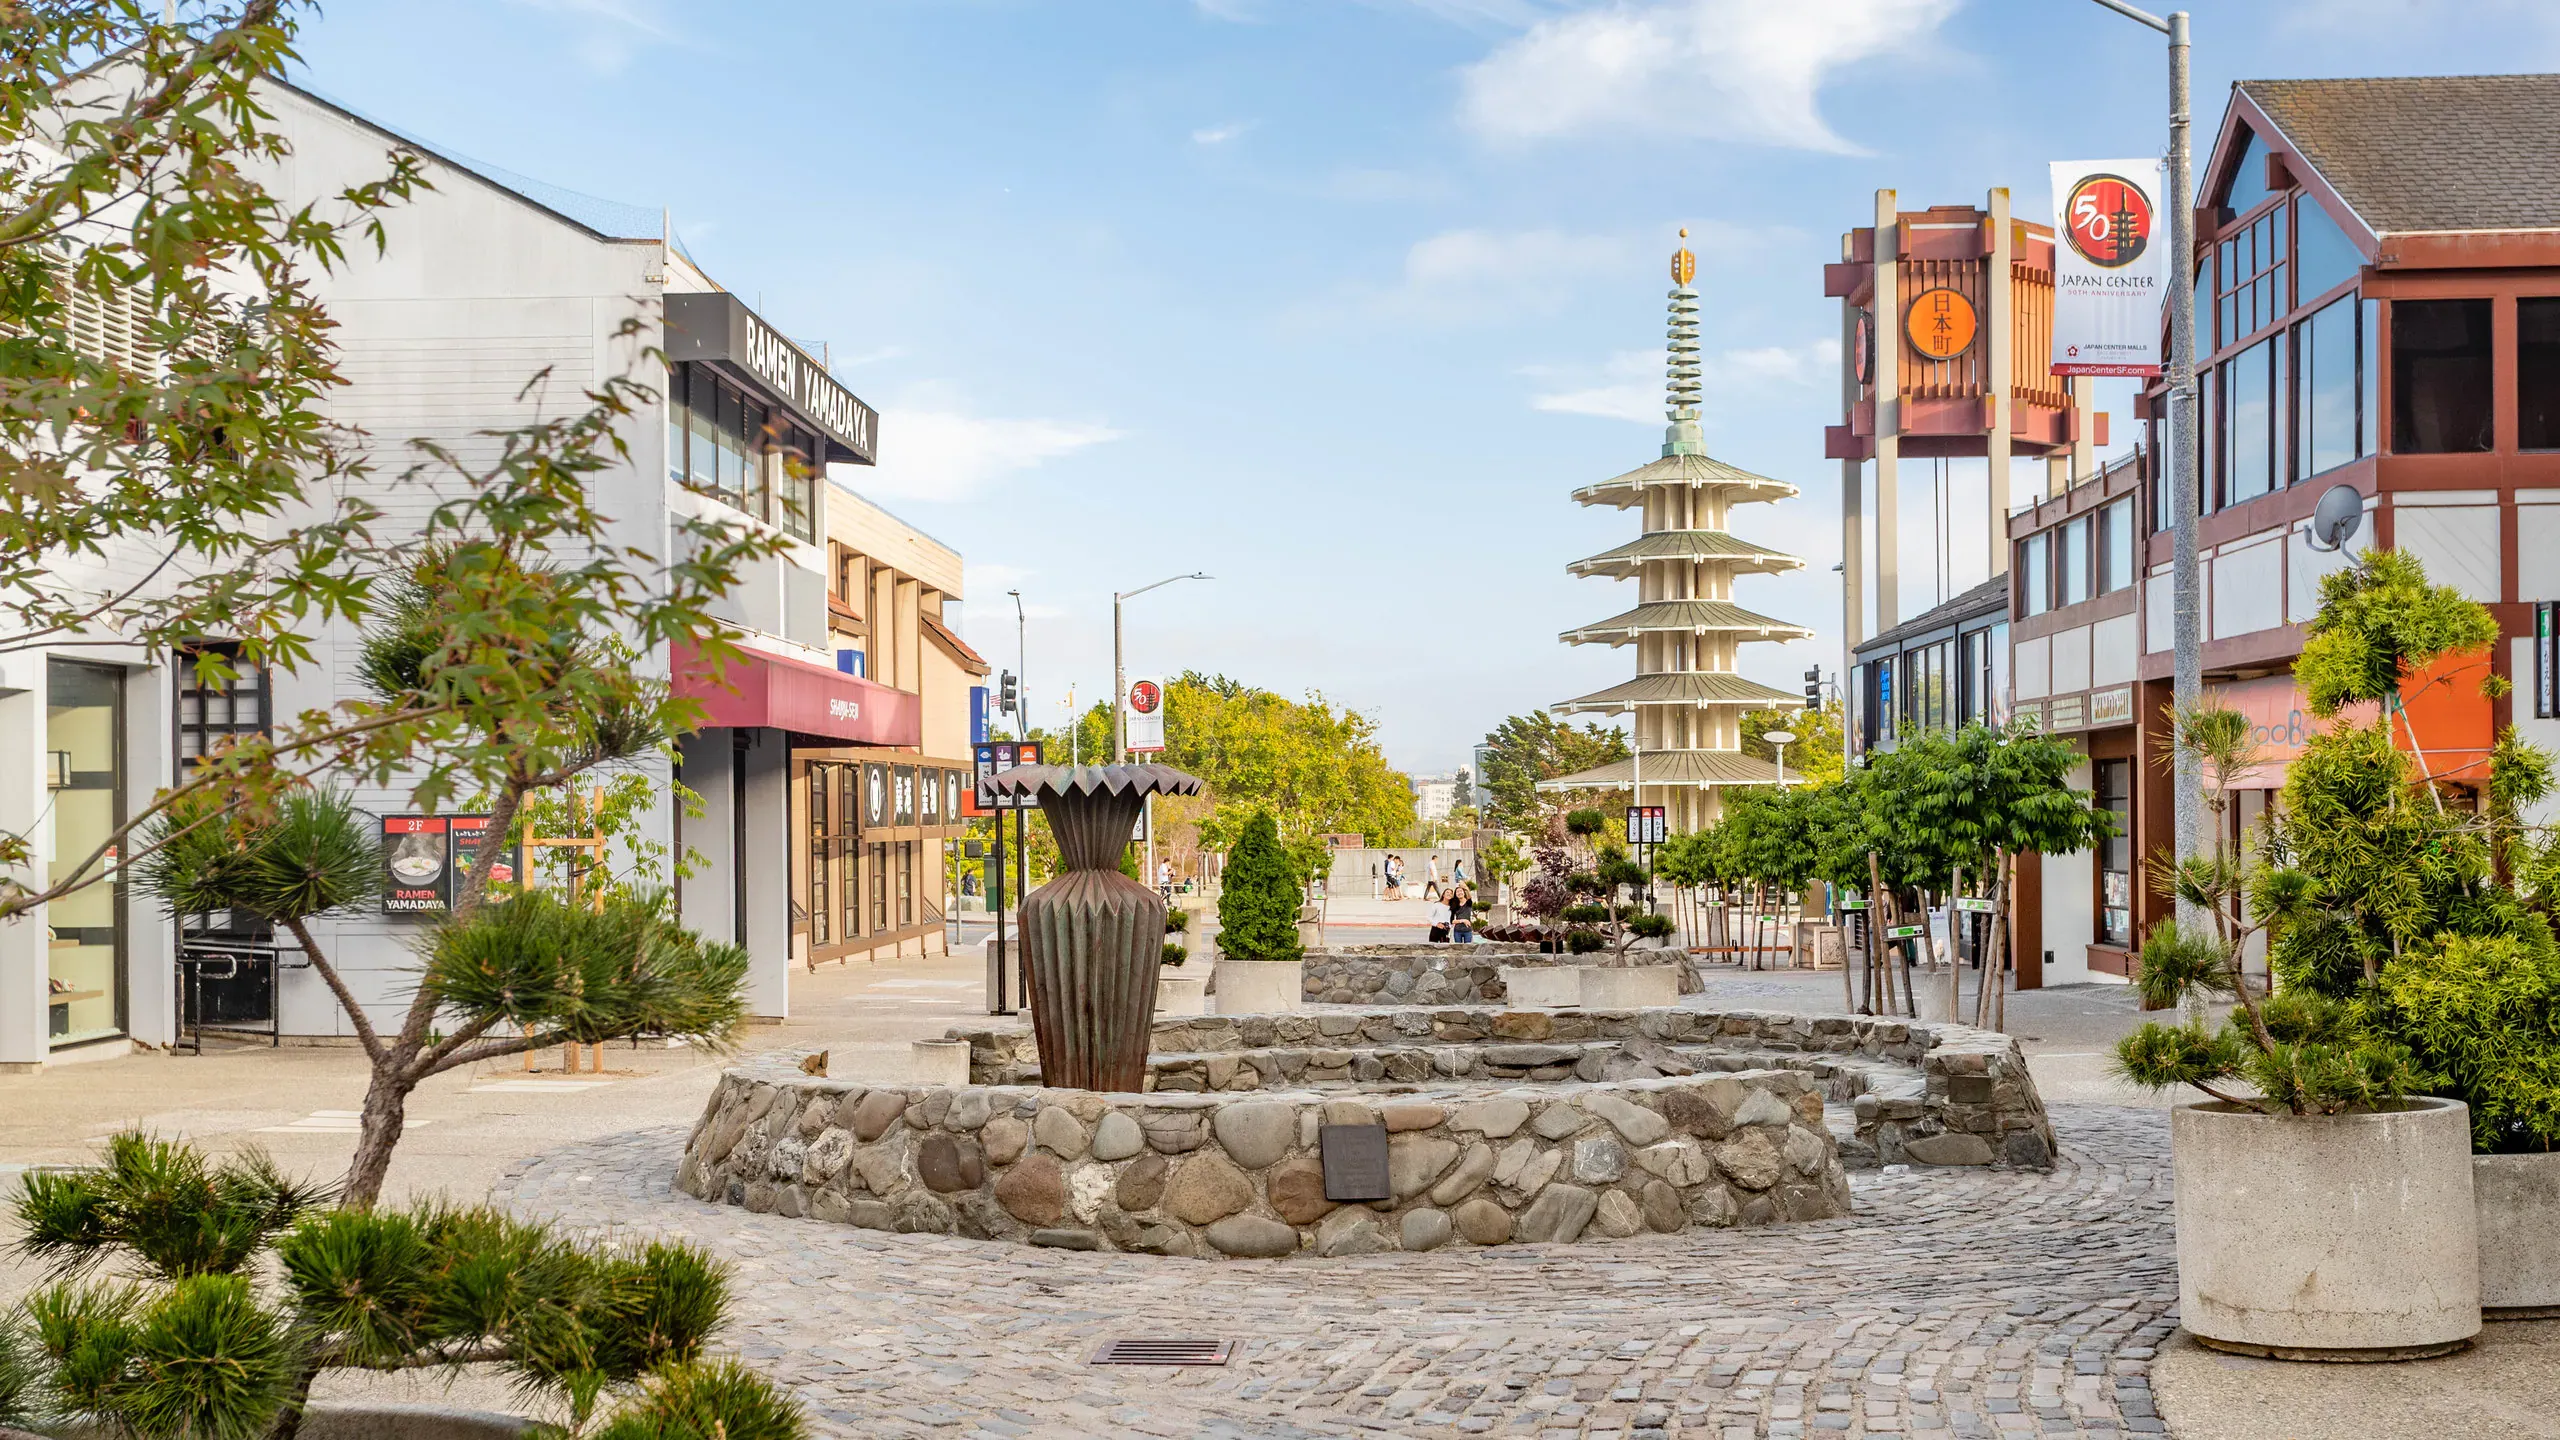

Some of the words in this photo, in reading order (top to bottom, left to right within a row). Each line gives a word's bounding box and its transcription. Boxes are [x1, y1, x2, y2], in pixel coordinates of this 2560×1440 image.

[2074, 195, 2110, 241] 50
[2061, 274, 2102, 287] JAPAN
[2106, 276, 2154, 288] CENTER
[1932, 293, 1952, 355] 日本町
[2067, 365, 2145, 375] JapanCenterSF.com
[746, 314, 796, 401] RAMEN
[803, 362, 868, 452] YAMADAYA
[1133, 687, 1147, 705] 50
[2095, 691, 2129, 720] KIMOCHI
[408, 820, 424, 831] 2F
[396, 890, 436, 899] RAMEN
[386, 900, 446, 910] YAMADAYA
